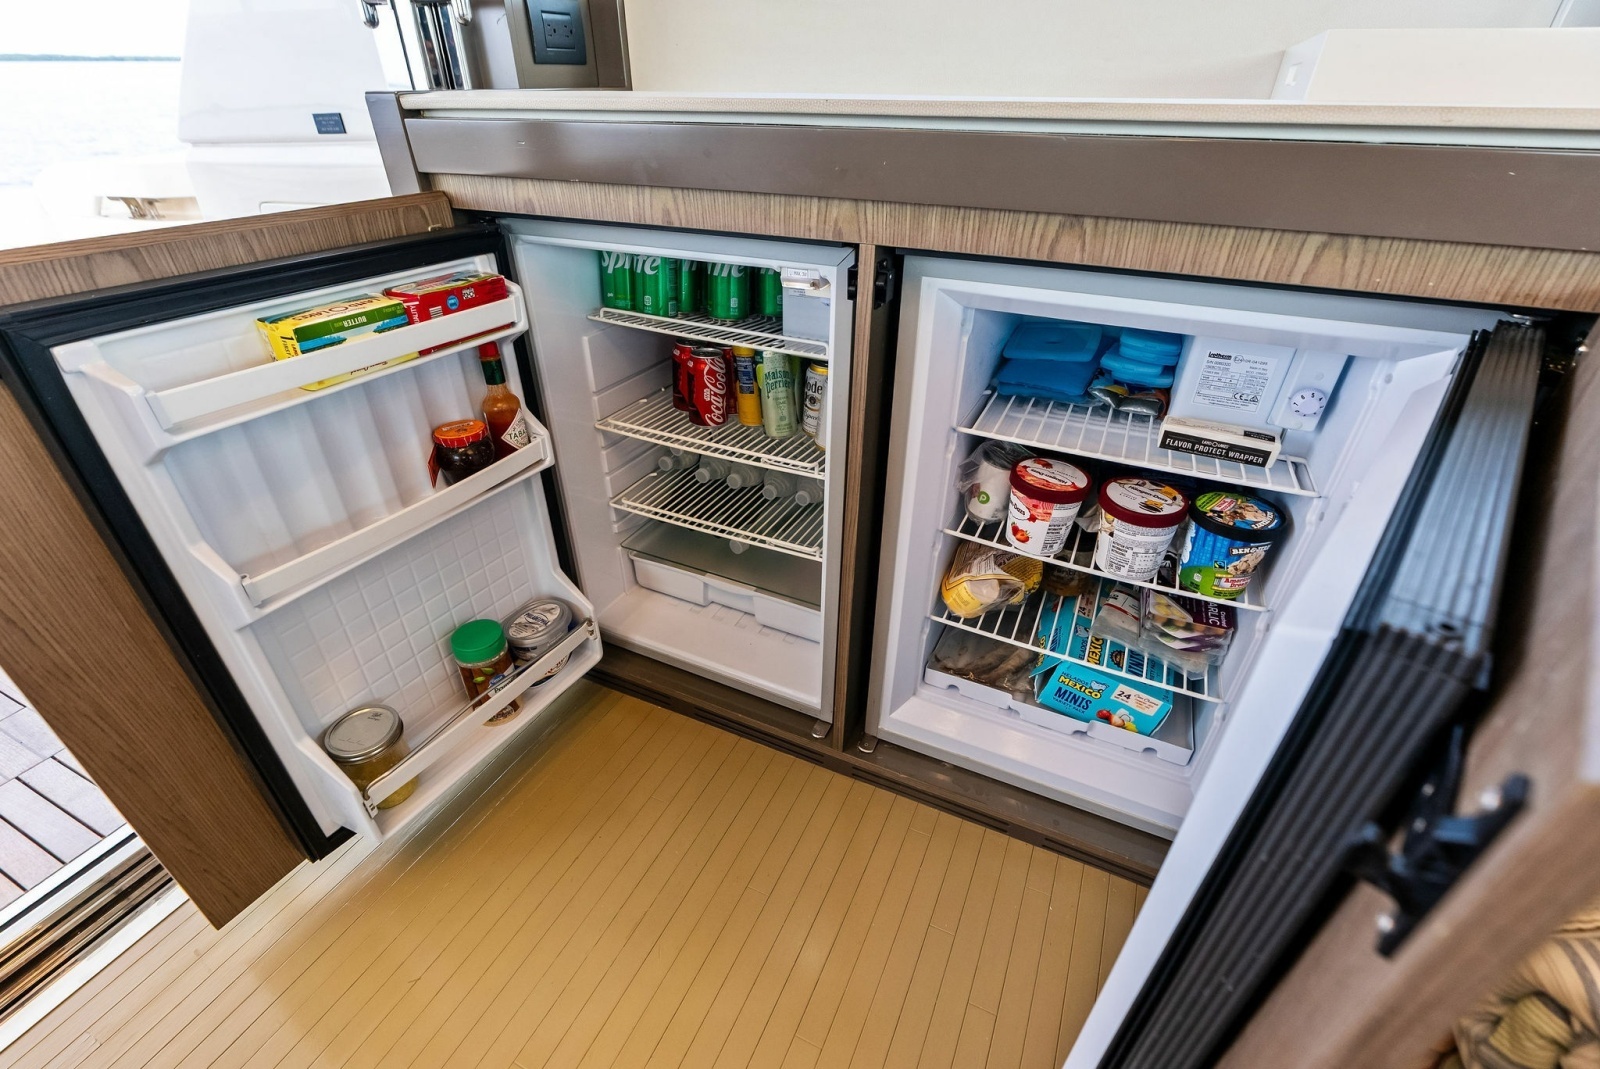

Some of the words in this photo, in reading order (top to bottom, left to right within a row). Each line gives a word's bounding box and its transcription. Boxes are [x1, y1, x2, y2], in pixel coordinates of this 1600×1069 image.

[343, 315, 367, 328] BUTTER
[764, 369, 791, 382] Maison
[765, 379, 791, 399] Perrier
[1165, 438, 1193, 450] FLAVOR
[1193, 443, 1226, 456] PROTECT
[1228, 450, 1264, 464] WRAPPER
[1208, 601, 1220, 626] ARLIC
[1079, 639, 1087, 660] ELADOS
[1088, 636, 1104, 665] MEXIC
[1058, 675, 1102, 700] MEXICO
[1061, 671, 1089, 686] HELADOS
[1053, 696, 1072, 708] VARIETY
[1072, 705, 1086, 714] PACK
[1054, 686, 1093, 710] MINIS
[1117, 690, 1131, 700] 24
